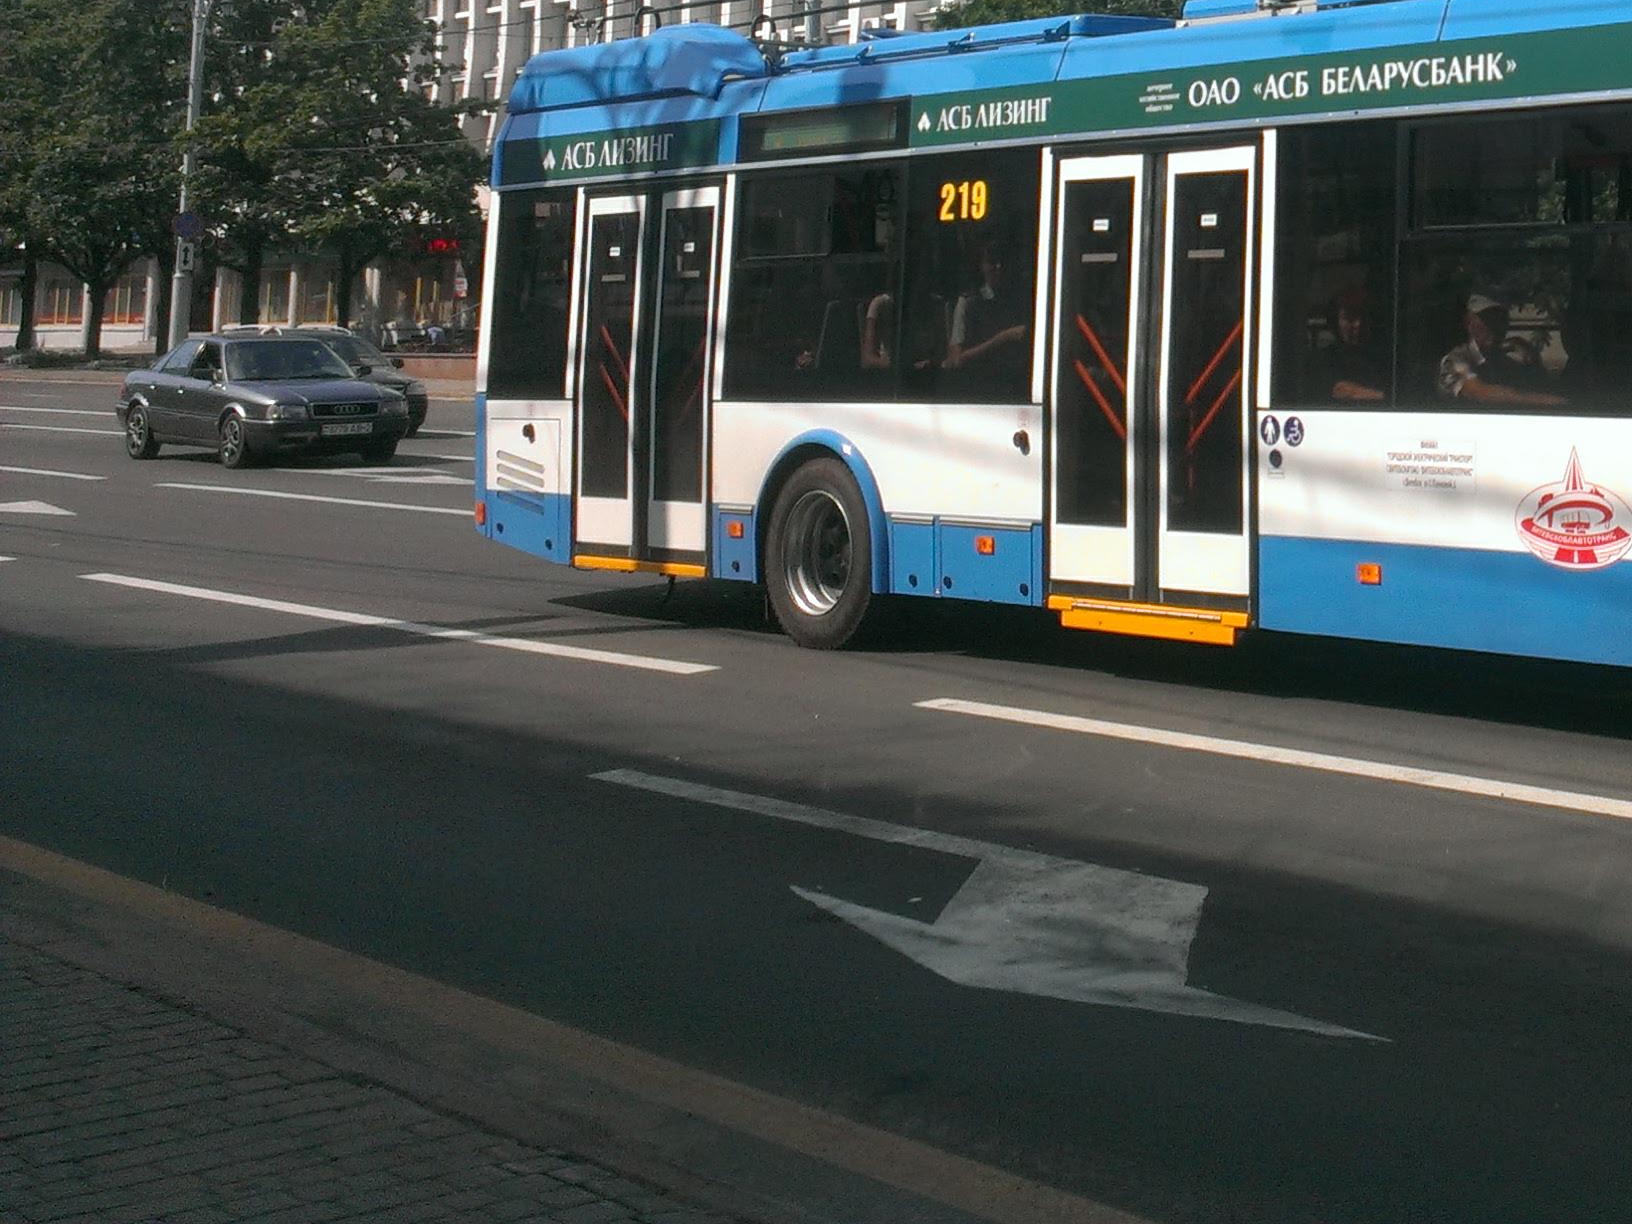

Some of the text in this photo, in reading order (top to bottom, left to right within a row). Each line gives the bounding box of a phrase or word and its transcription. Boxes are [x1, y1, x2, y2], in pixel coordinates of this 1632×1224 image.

[1188, 51, 1518, 108] ОАО «АСБ БЕЛАРУСБАНК»
[936, 96, 1052, 132] АСБ ЛИЗИНГ
[560, 133, 674, 171] АСБ ЛИЗИНГ
[939, 179, 988, 222] 219
